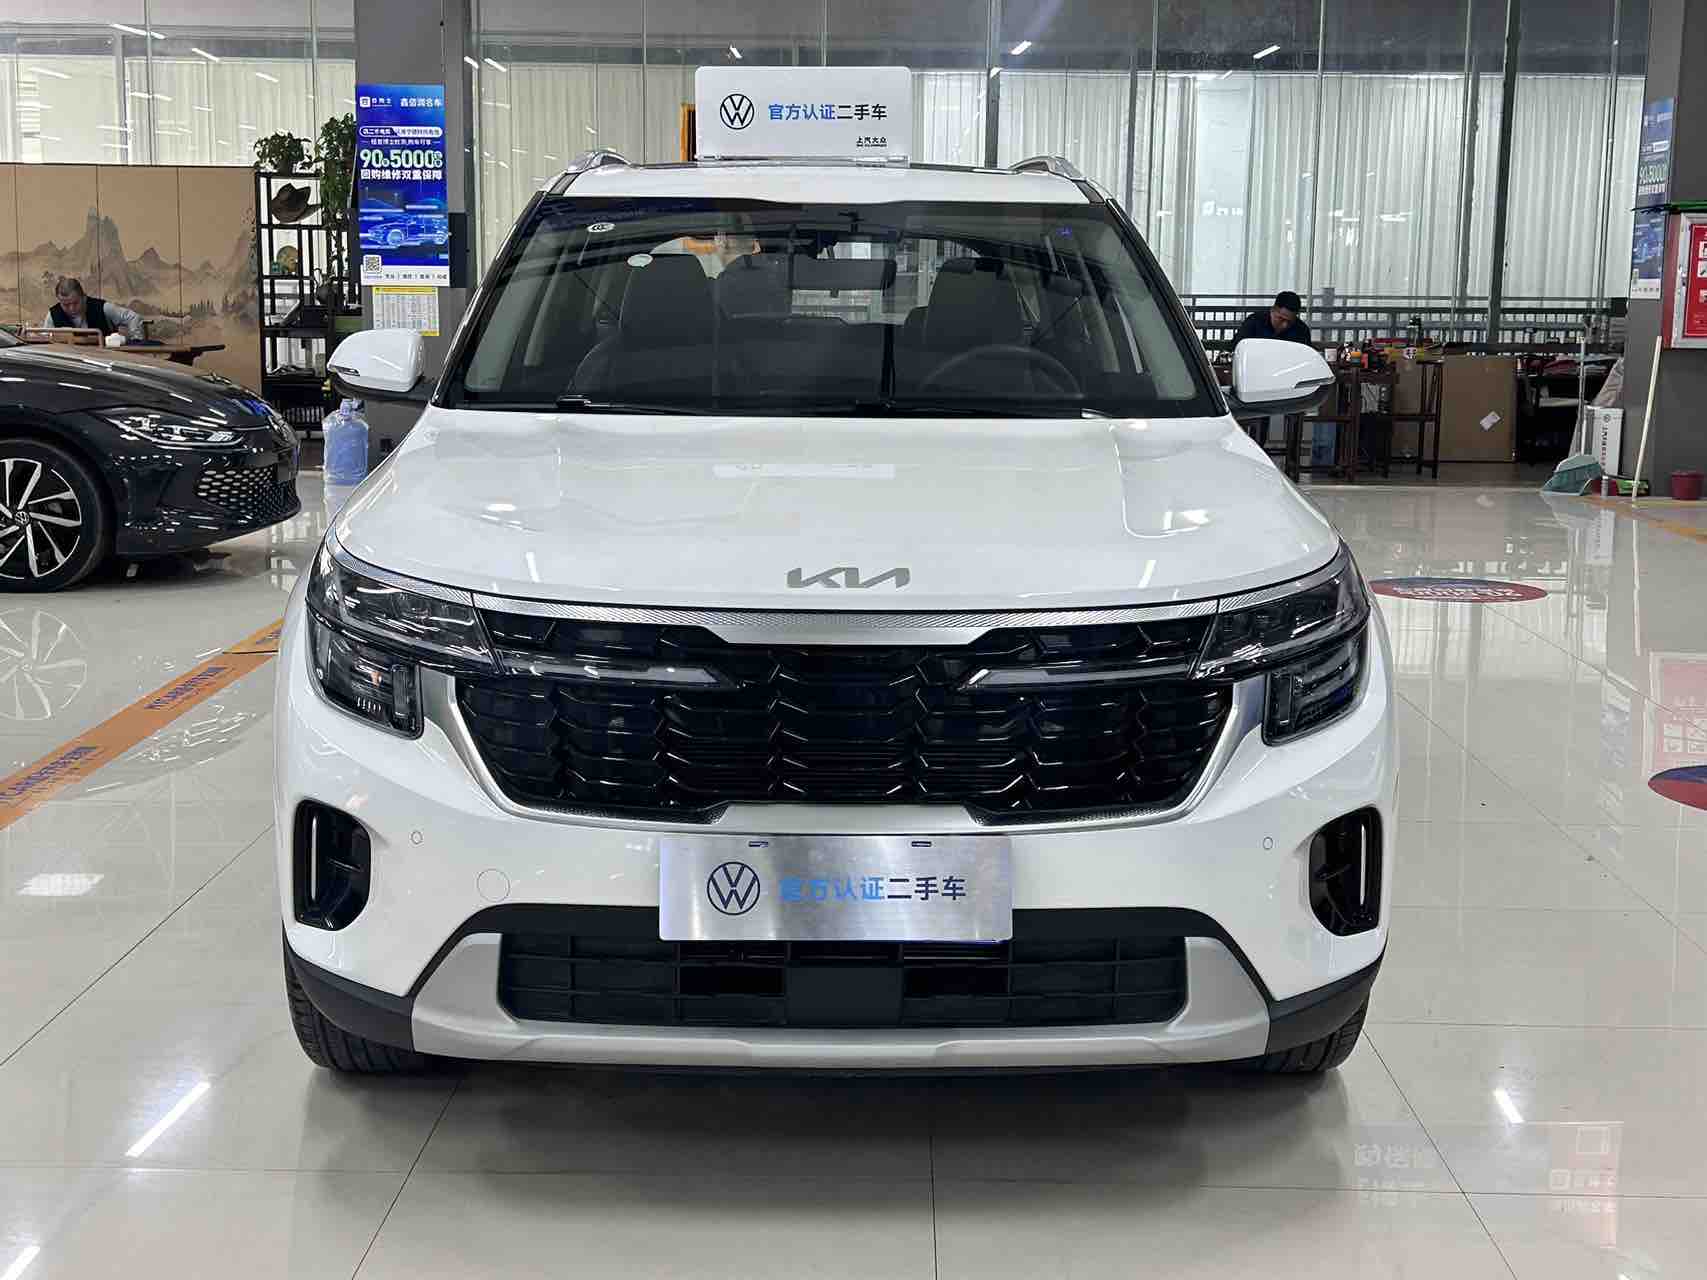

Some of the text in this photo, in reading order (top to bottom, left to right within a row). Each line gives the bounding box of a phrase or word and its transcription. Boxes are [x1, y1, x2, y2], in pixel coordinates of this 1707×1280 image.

[768, 103, 888, 121] 官方认证二手车
[856, 135, 888, 144] 上汽大众
[786, 567, 911, 589] KIA
[778, 874, 967, 902] 官方认证二手车
